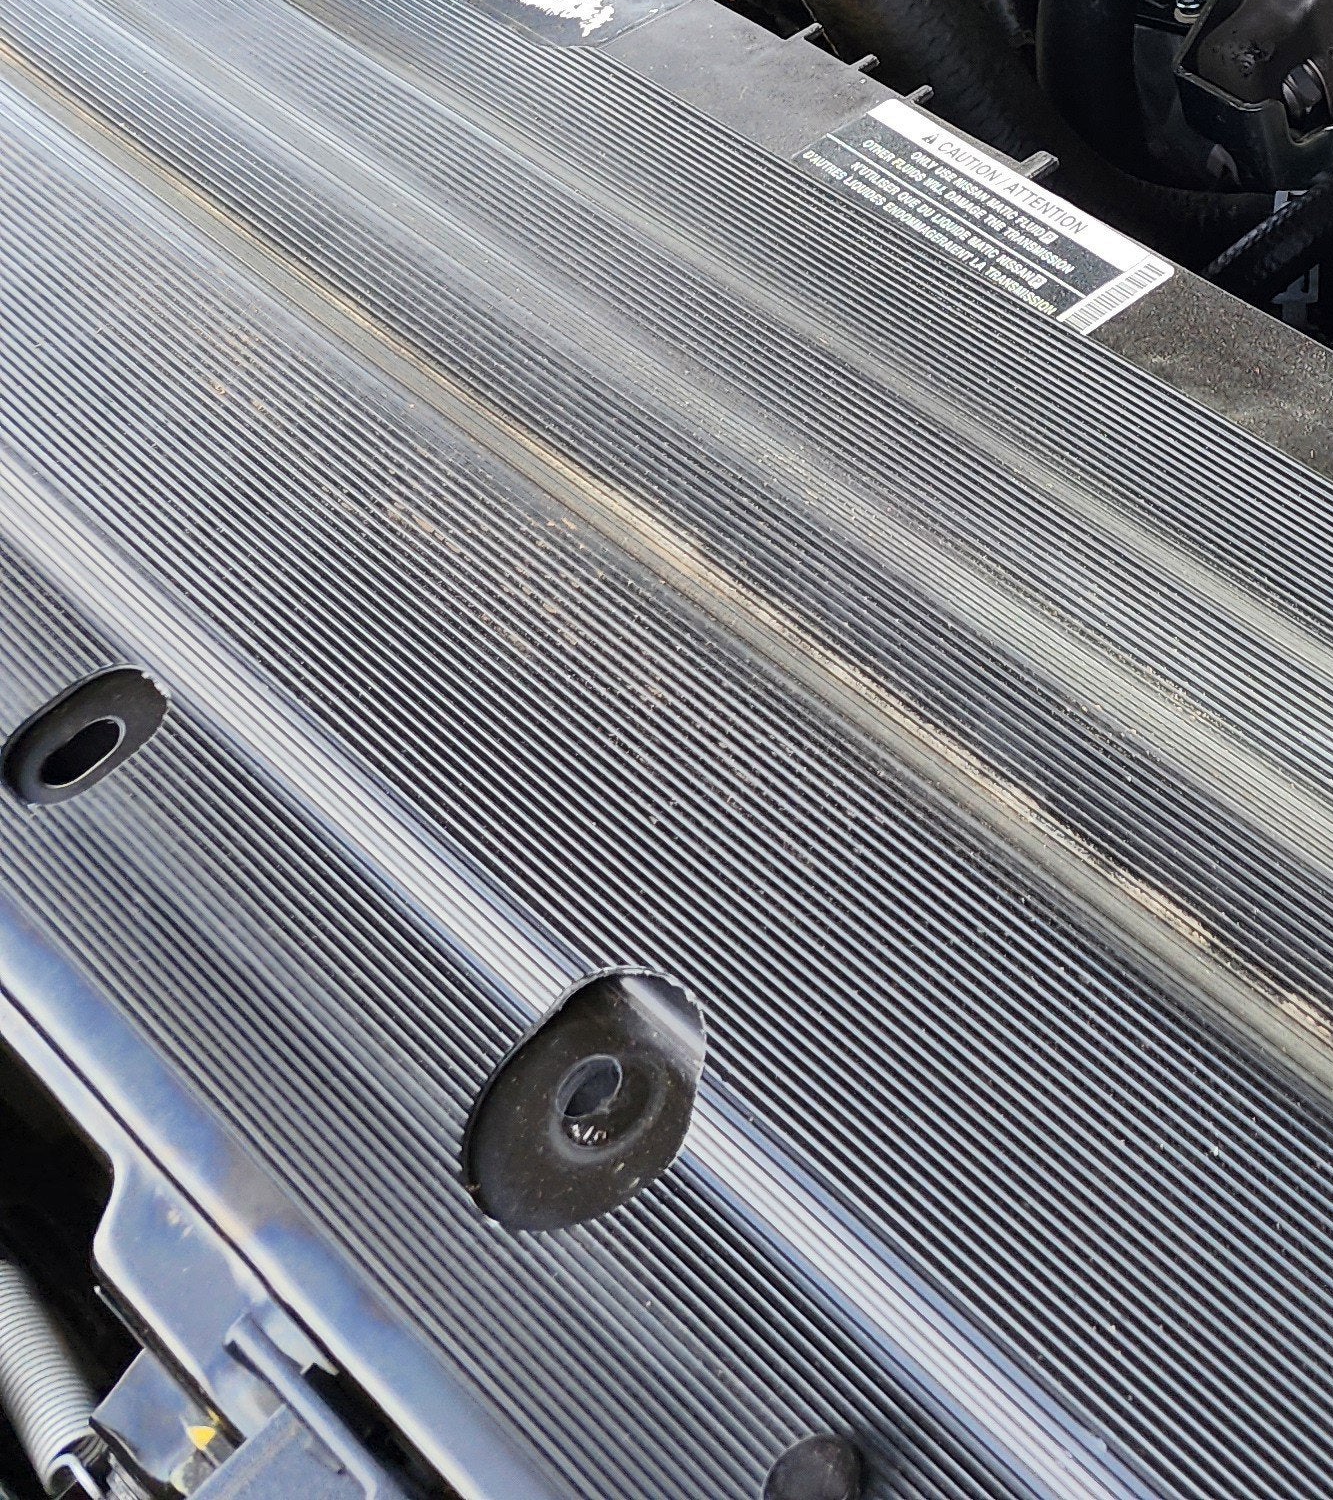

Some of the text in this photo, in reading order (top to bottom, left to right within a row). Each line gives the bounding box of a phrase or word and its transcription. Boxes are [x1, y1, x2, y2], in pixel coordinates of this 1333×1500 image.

[803, 150, 1058, 315] D'AUTRES LIQUIDES ENDOMMAGERAIENT LA TRANSMISSION
[850, 161, 900, 195] N'UTILISER
[897, 191, 921, 208] QUE
[916, 203, 936, 217] DU
[931, 213, 972, 240] LIQUIDE
[967, 235, 999, 258] MATIC
[995, 254, 1036, 282] NISSAN
[862, 139, 1075, 274] OTHER FLUIDS WILL DAMAGE THE TRANSMISSION
[911, 151, 939, 169] ONLY
[934, 166, 957, 182] USE
[952, 177, 990, 202] NISSAN
[986, 197, 1018, 220] MATIC
[1015, 215, 1046, 236] FLUID
[938, 142, 1002, 182] CAUTION
[1003, 183, 1088, 234] ATTENTION
